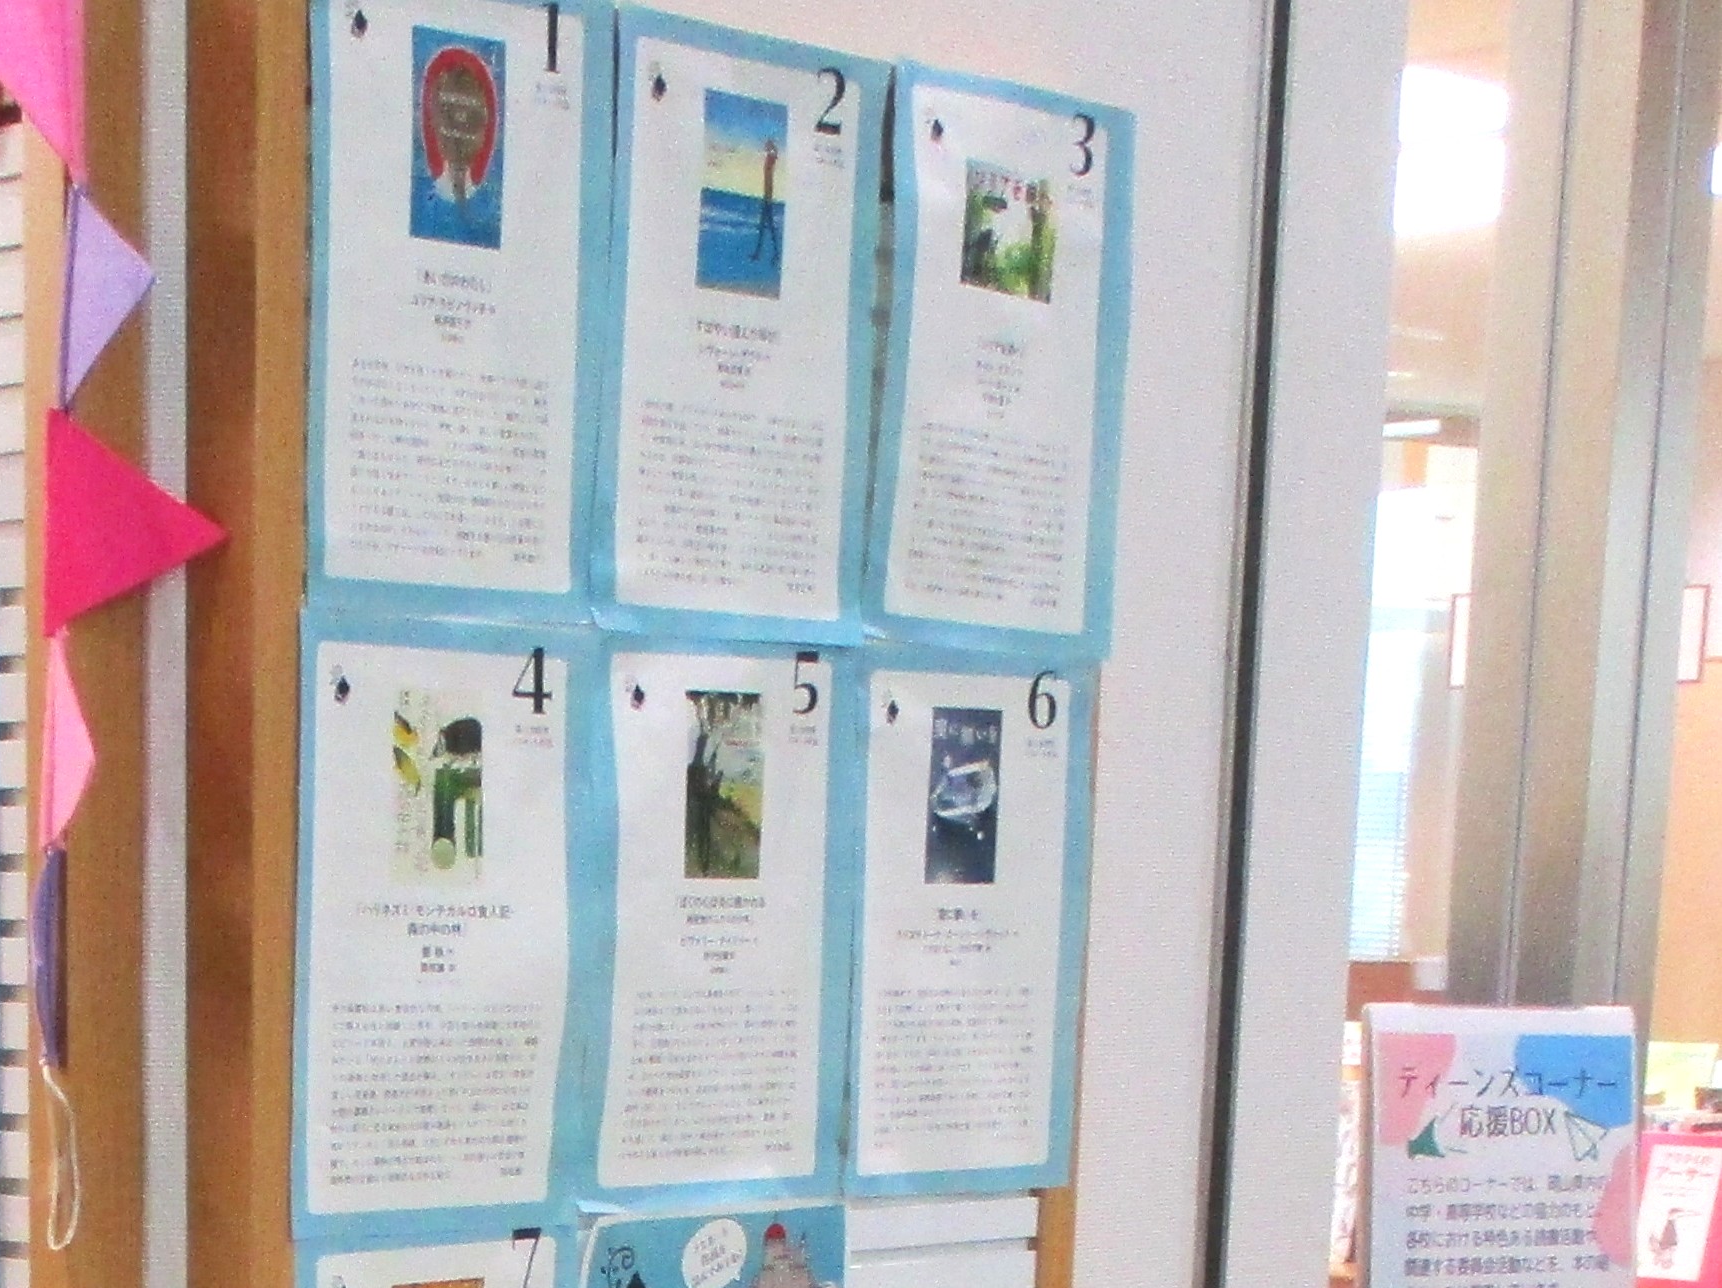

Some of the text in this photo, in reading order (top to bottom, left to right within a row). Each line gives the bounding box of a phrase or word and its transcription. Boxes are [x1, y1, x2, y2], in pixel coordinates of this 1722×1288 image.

[544, 4, 560, 72] 1
[814, 67, 847, 135] 2
[1070, 113, 1096, 176] 3
[512, 646, 553, 715] 4
[792, 651, 819, 714] 5
[1027, 669, 1057, 730] 6
[1398, 1066, 1618, 1101] ティーンズコーナー
[1457, 1103, 1558, 1139] 応援BOX
